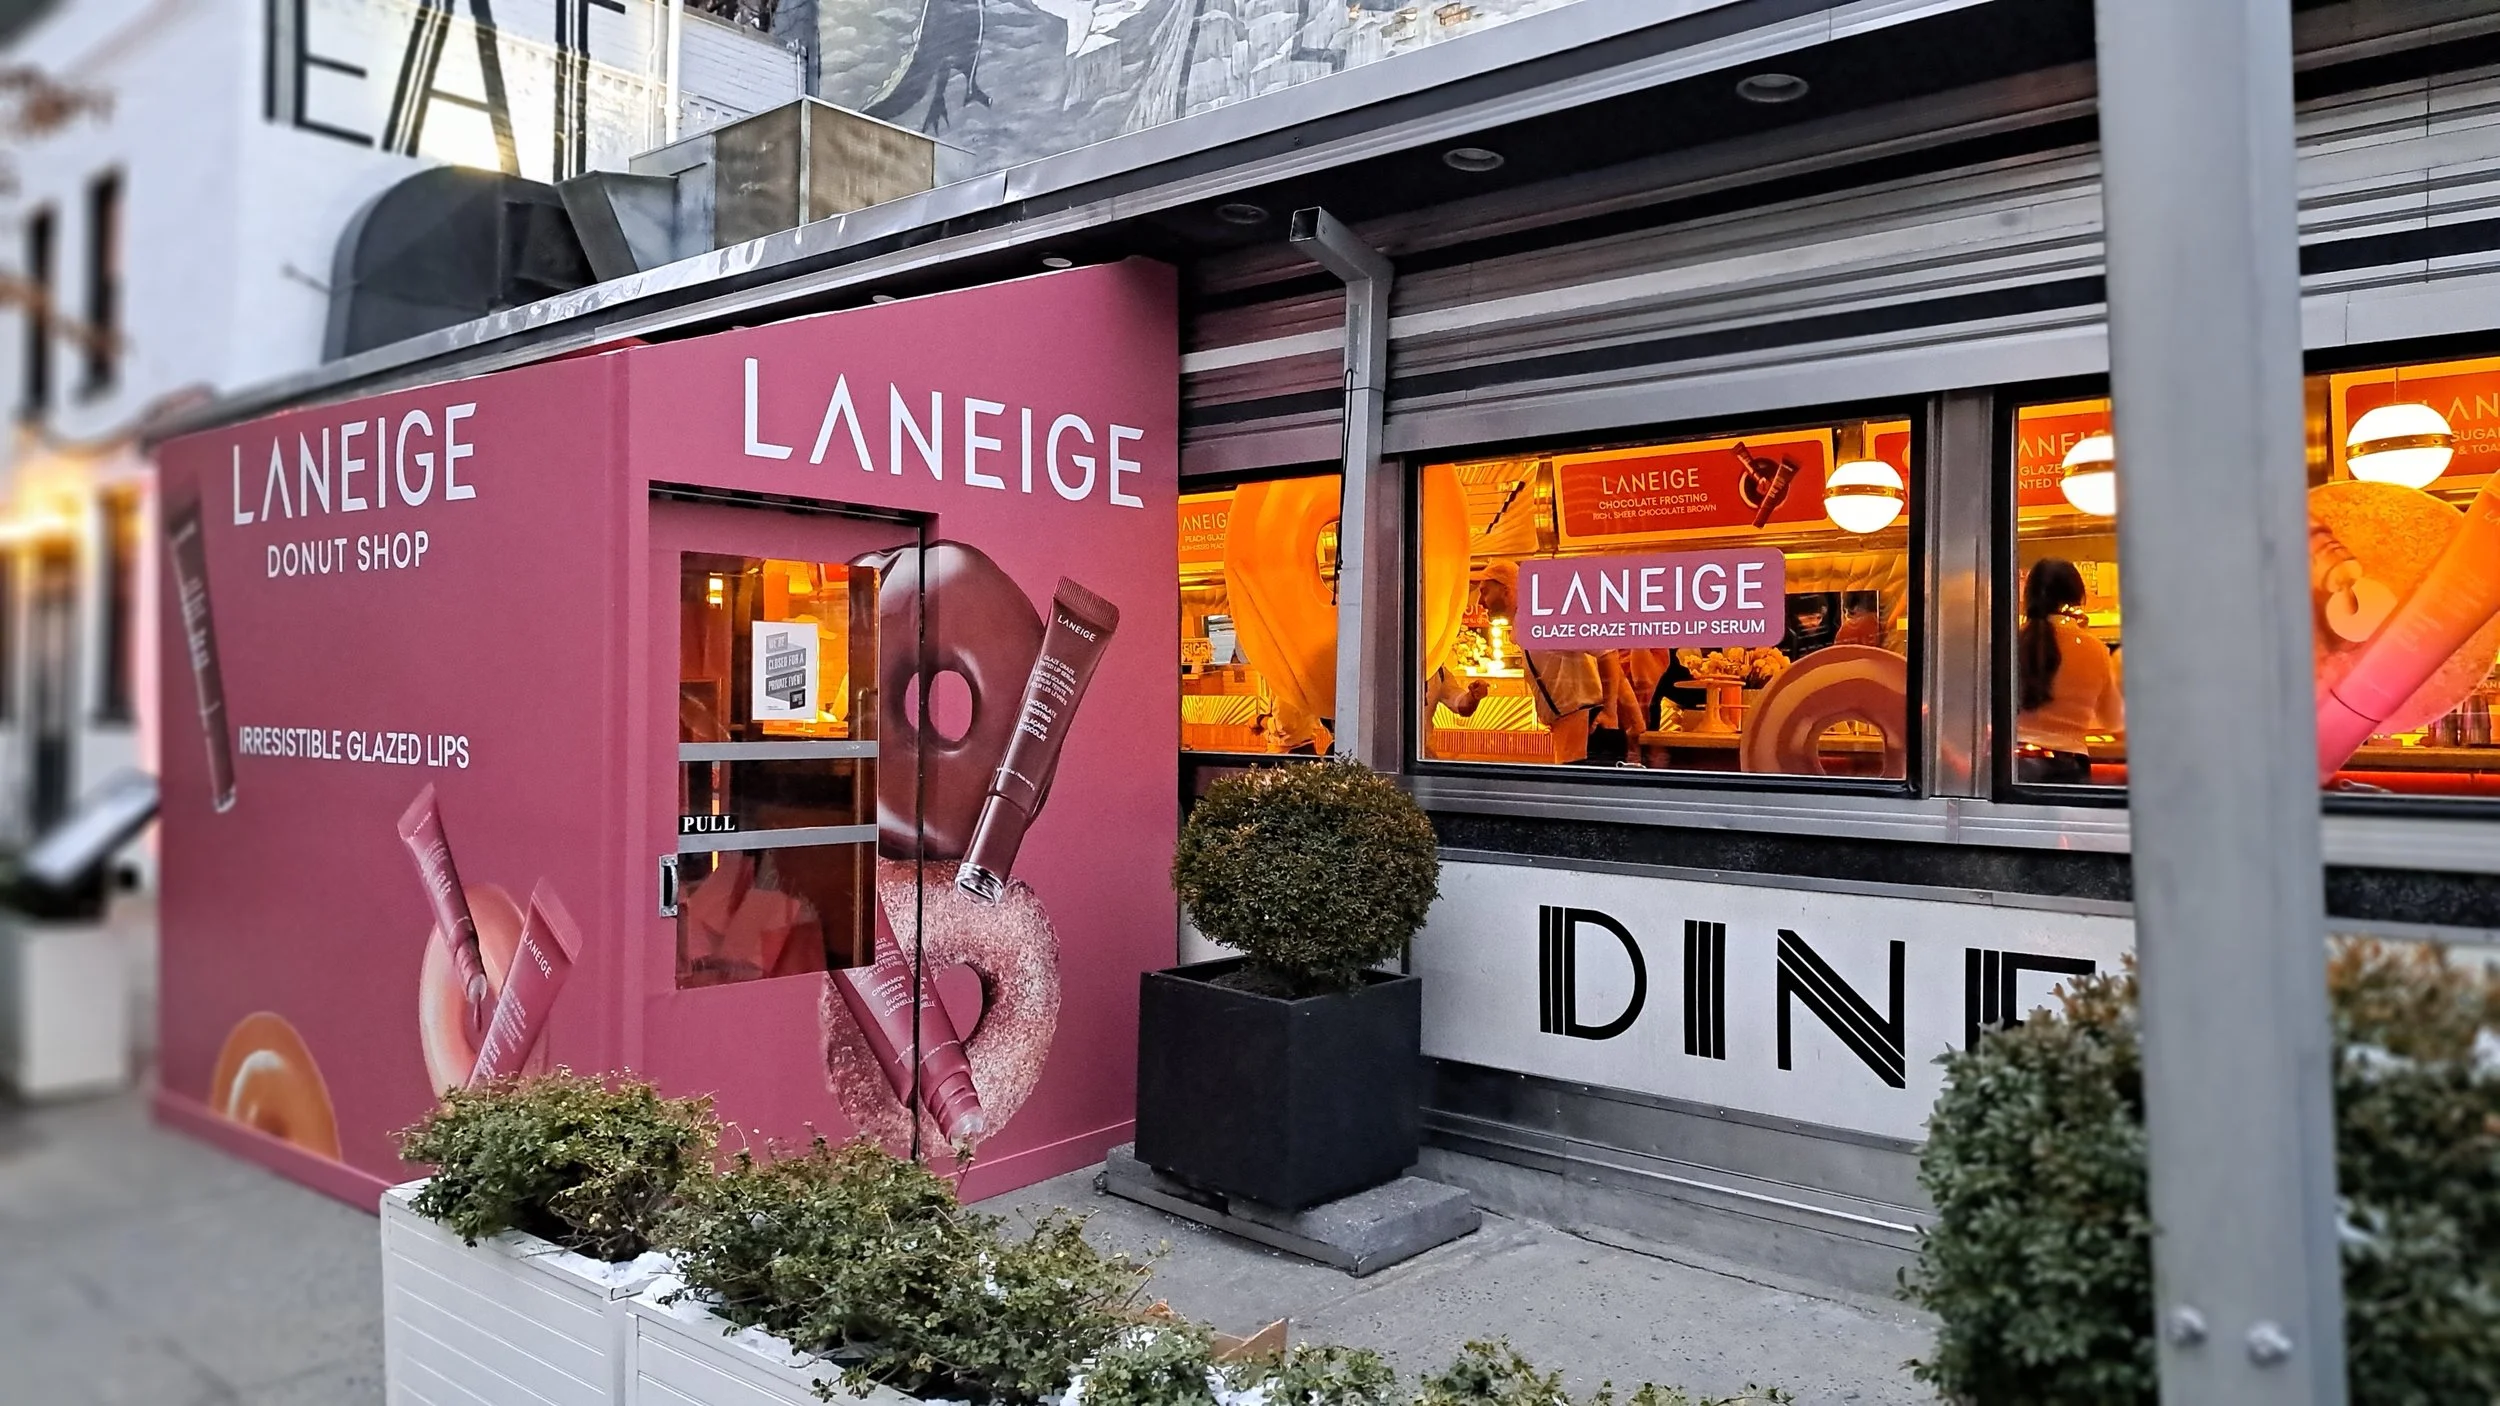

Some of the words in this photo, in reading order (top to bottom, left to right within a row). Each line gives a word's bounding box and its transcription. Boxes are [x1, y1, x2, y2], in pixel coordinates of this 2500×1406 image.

[744, 358, 1144, 509] LANEIGE
[2450, 427, 2500, 442] SUGA
[2472, 443, 2500, 454] TOA
[234, 402, 477, 526] LANEIGE
[1602, 467, 1700, 495] LANEIGE
[1599, 498, 1658, 510] CHOCOLATE
[1659, 493, 1708, 506] FROSTING
[1613, 509, 1636, 519] SHEER
[1638, 506, 1685, 517] CHOCOLATE
[1687, 504, 1717, 514] BROWN
[1182, 512, 1228, 531] ANEIG
[267, 538, 348, 578] DONUT
[357, 530, 429, 572] SHOP
[1531, 562, 1765, 616] LANEIGE
[1057, 614, 1097, 642] LANEIGE
[1531, 623, 1575, 638] GLAZE
[1579, 622, 1625, 637] CRAZE
[1629, 621, 1681, 636] TINTED
[1685, 620, 1708, 635] LIP
[1711, 619, 1765, 634] SERUM
[768, 656, 788, 670] CLOSED
[788, 654, 799, 667] FOR
[1026, 698, 1057, 718] CHOCOLATE
[239, 726, 342, 760] IRRESISTIBLE
[346, 730, 421, 765] GLAZED
[427, 734, 470, 769] LIPS
[682, 816, 735, 832] PULL
[523, 931, 553, 980] LANEIGE
[871, 974, 905, 996] CINNAMON
[880, 982, 903, 997] SUGAR
[885, 991, 907, 1006] SUCRE
